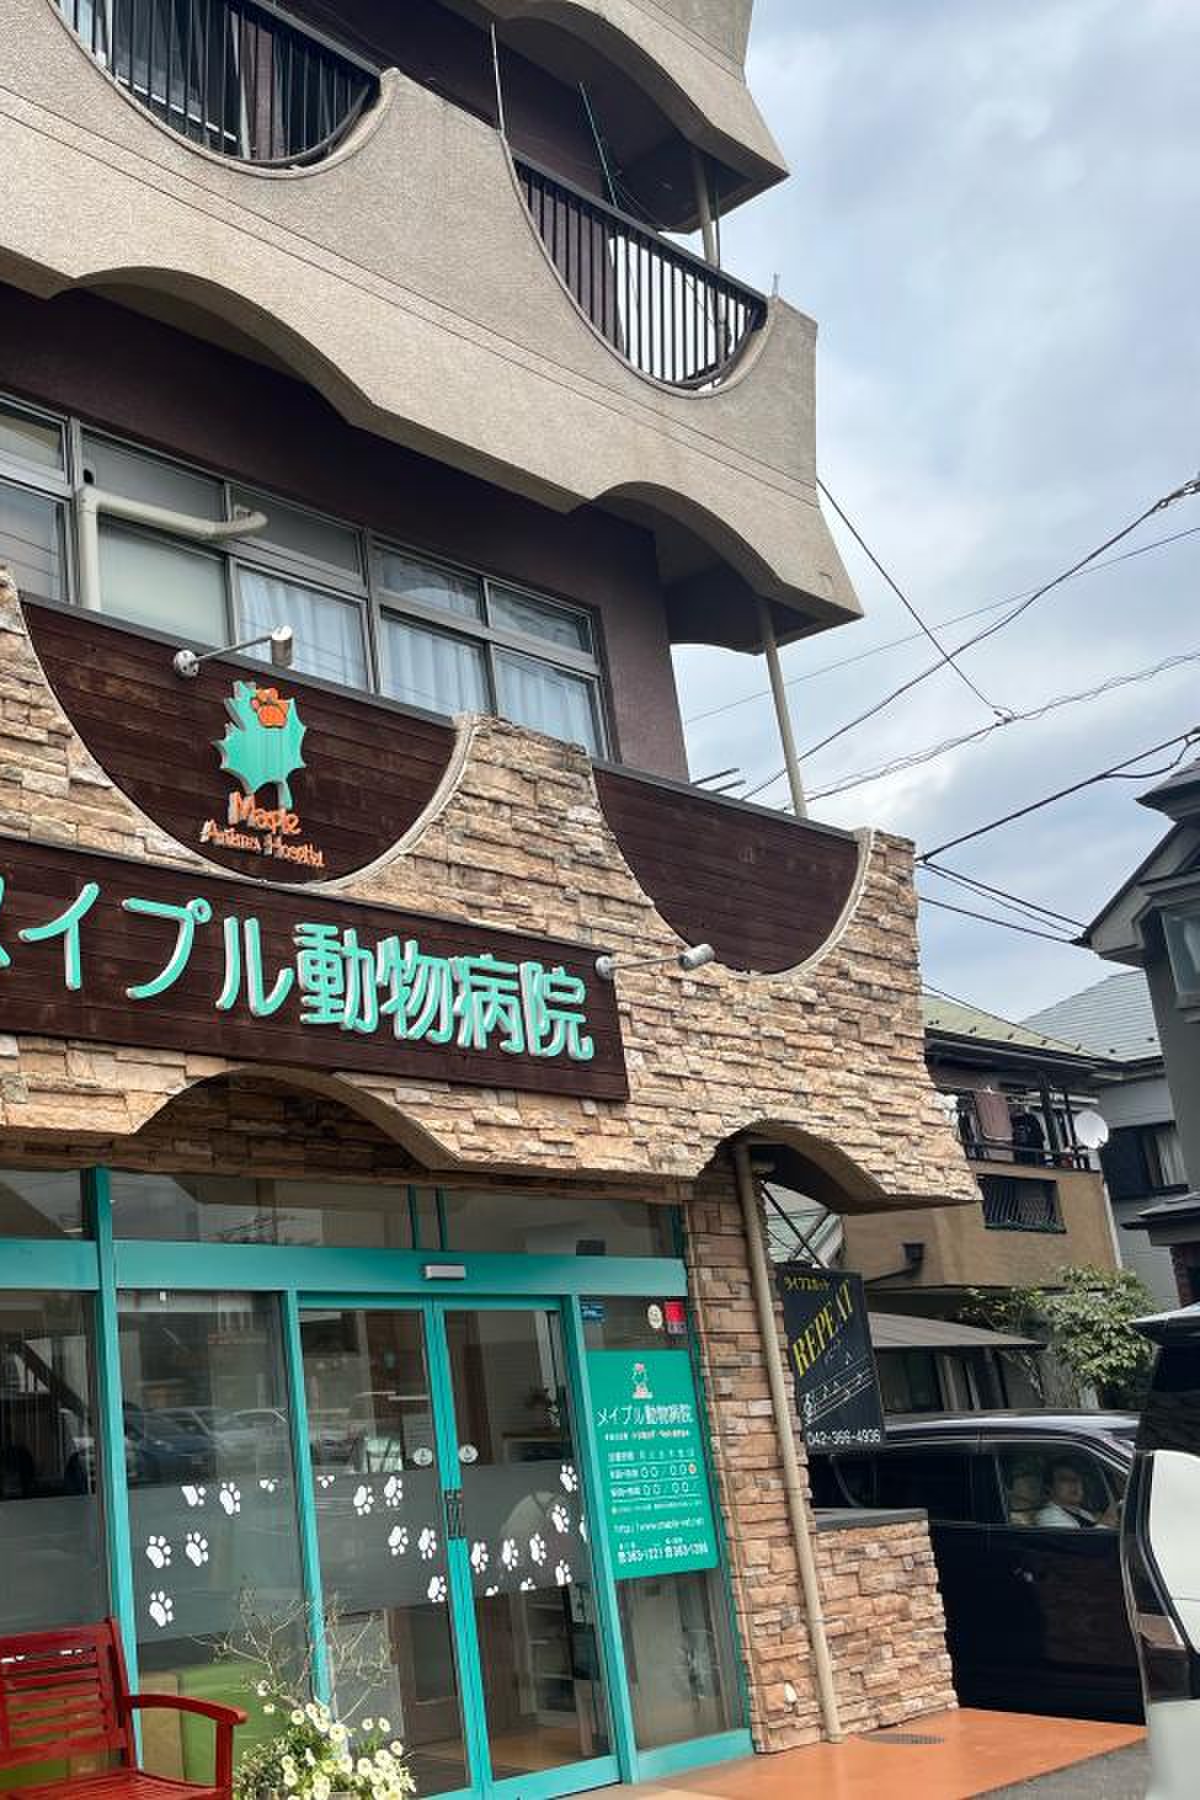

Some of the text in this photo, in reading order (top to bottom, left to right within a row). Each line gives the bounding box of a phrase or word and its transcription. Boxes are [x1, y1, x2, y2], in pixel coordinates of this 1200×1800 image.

[227, 790, 302, 835] Maple
[792, 1278, 853, 1377] REPEAT
[596, 1403, 694, 1426] メイプル動物病院
